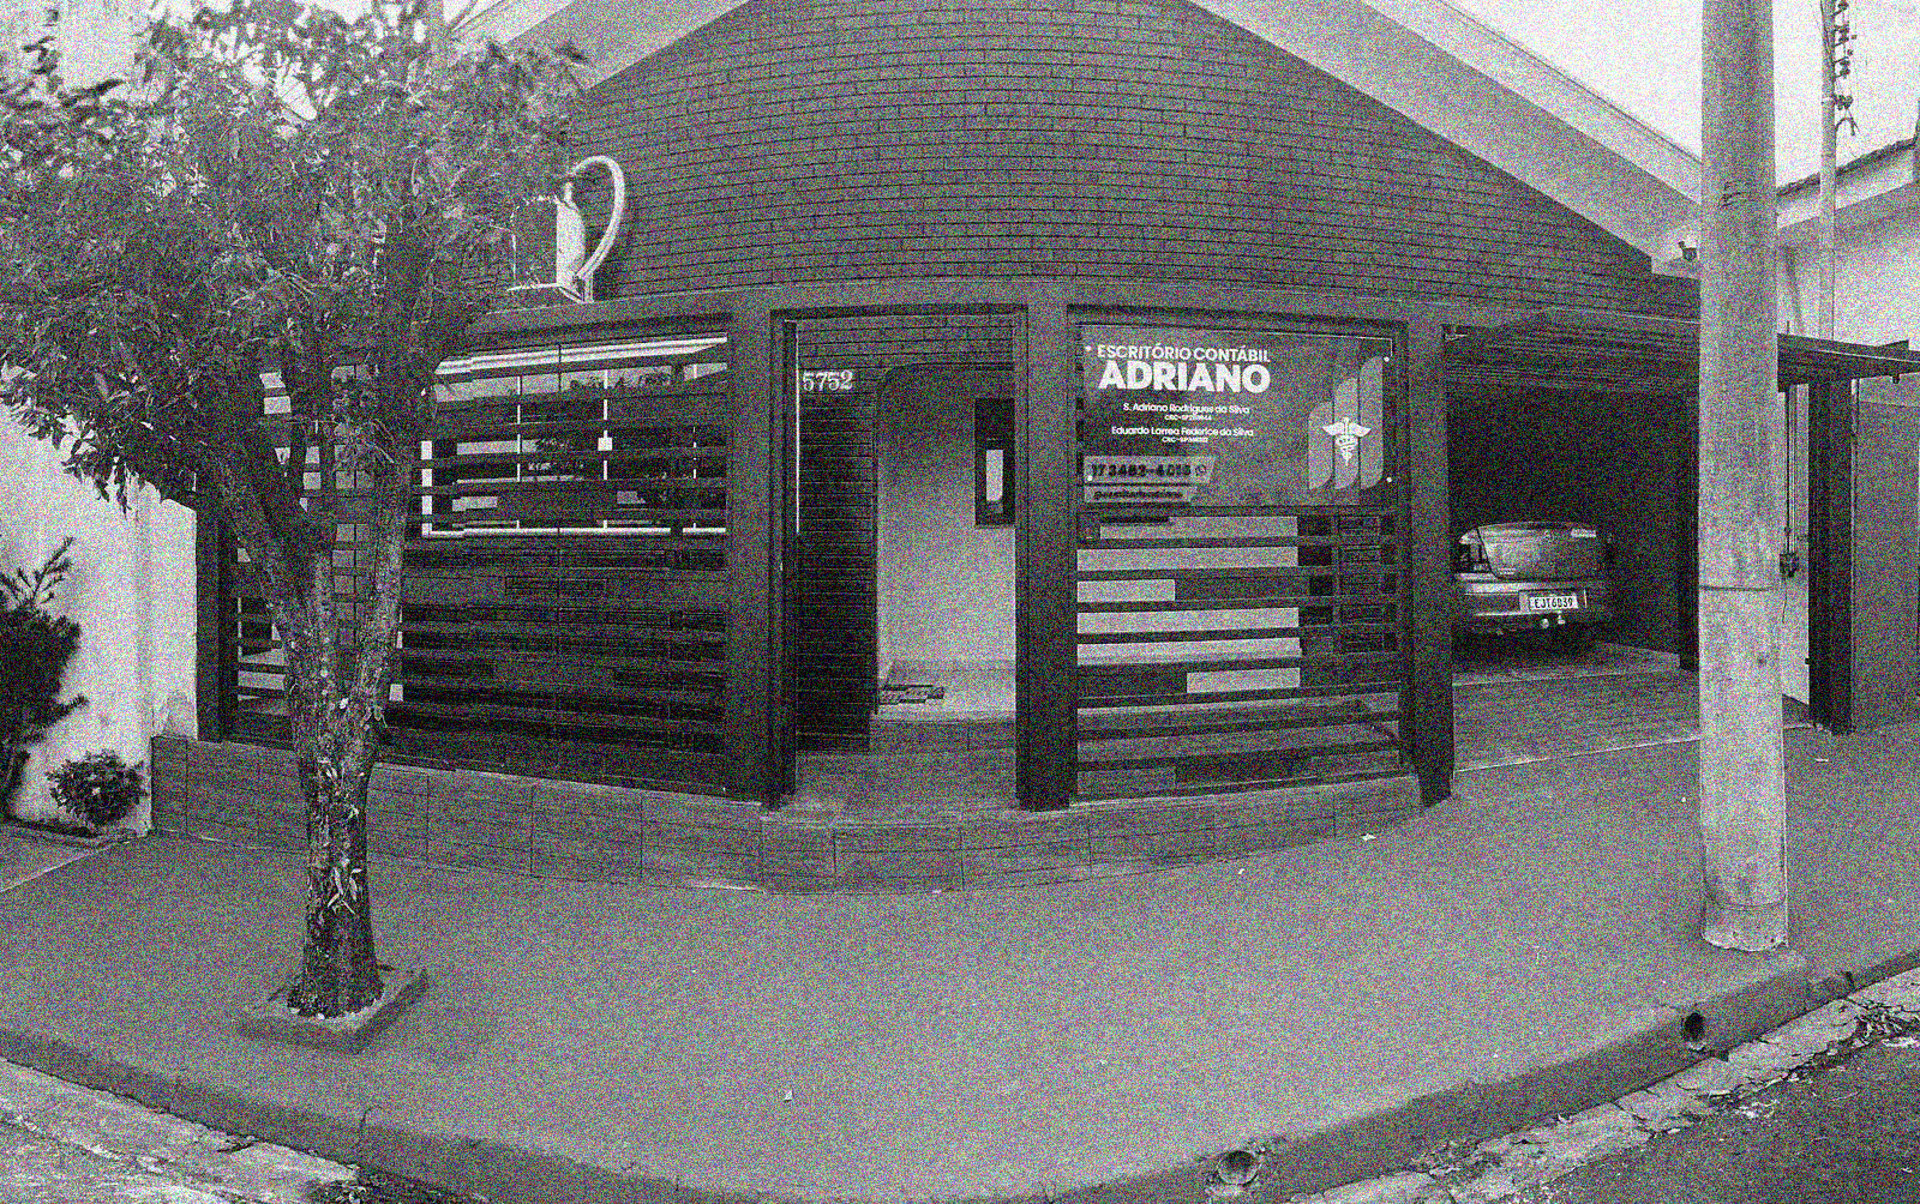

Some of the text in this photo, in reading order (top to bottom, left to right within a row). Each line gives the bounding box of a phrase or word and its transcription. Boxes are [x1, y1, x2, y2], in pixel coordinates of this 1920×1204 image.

[1097, 343, 1271, 363] ESCRITÓRIO CONTÁBIL
[802, 370, 853, 391] 5752
[1098, 359, 1271, 394] ADRIANO
[1133, 402, 1169, 412] Adriano
[1229, 404, 1250, 414] Silva
[1111, 426, 1149, 435] Eduardo
[1232, 427, 1254, 437] Silva
